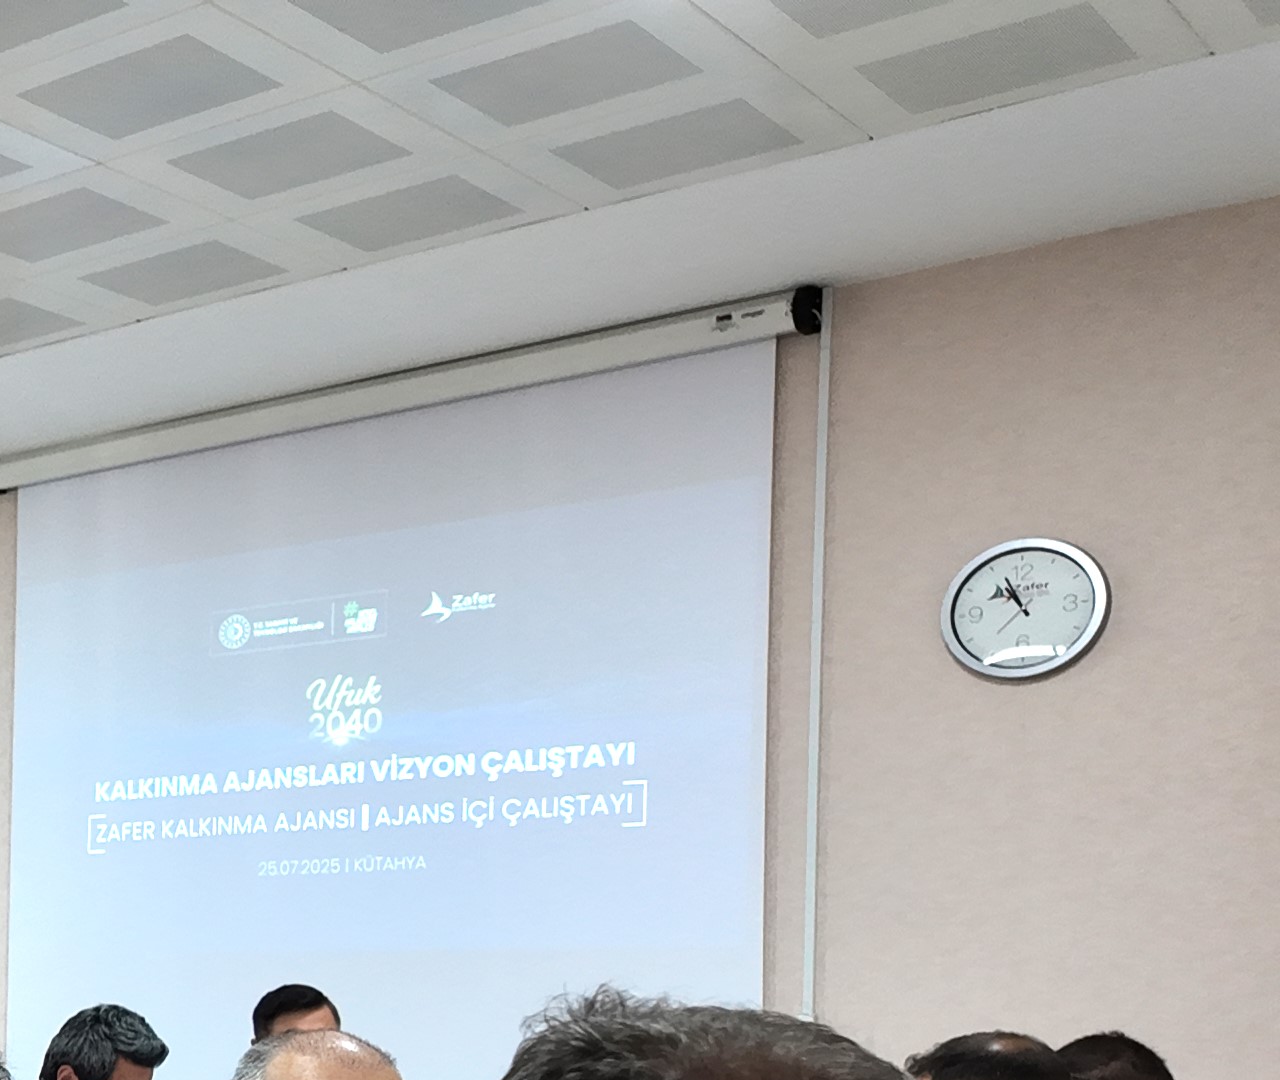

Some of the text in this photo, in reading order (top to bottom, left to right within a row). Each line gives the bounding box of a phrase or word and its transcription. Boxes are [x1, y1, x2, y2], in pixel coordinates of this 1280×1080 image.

[1011, 563, 1034, 581] 12
[451, 592, 496, 608] Zafer
[1062, 593, 1079, 612] 3
[968, 605, 984, 624] 9
[306, 673, 382, 711] Ufuk
[308, 707, 383, 737] 2040
[94, 741, 636, 802] KALKINMA AJANSLARI VİZYON ÇALIŞTAYI
[95, 821, 156, 843] ZAFER
[161, 814, 268, 839] KALKINMA
[273, 808, 355, 832] AJANSI
[374, 802, 455, 827] AJANS
[461, 796, 495, 828] İÇİ
[501, 793, 633, 827] ÇALIŞTAYI
[354, 855, 427, 873] KÜTAHYA
